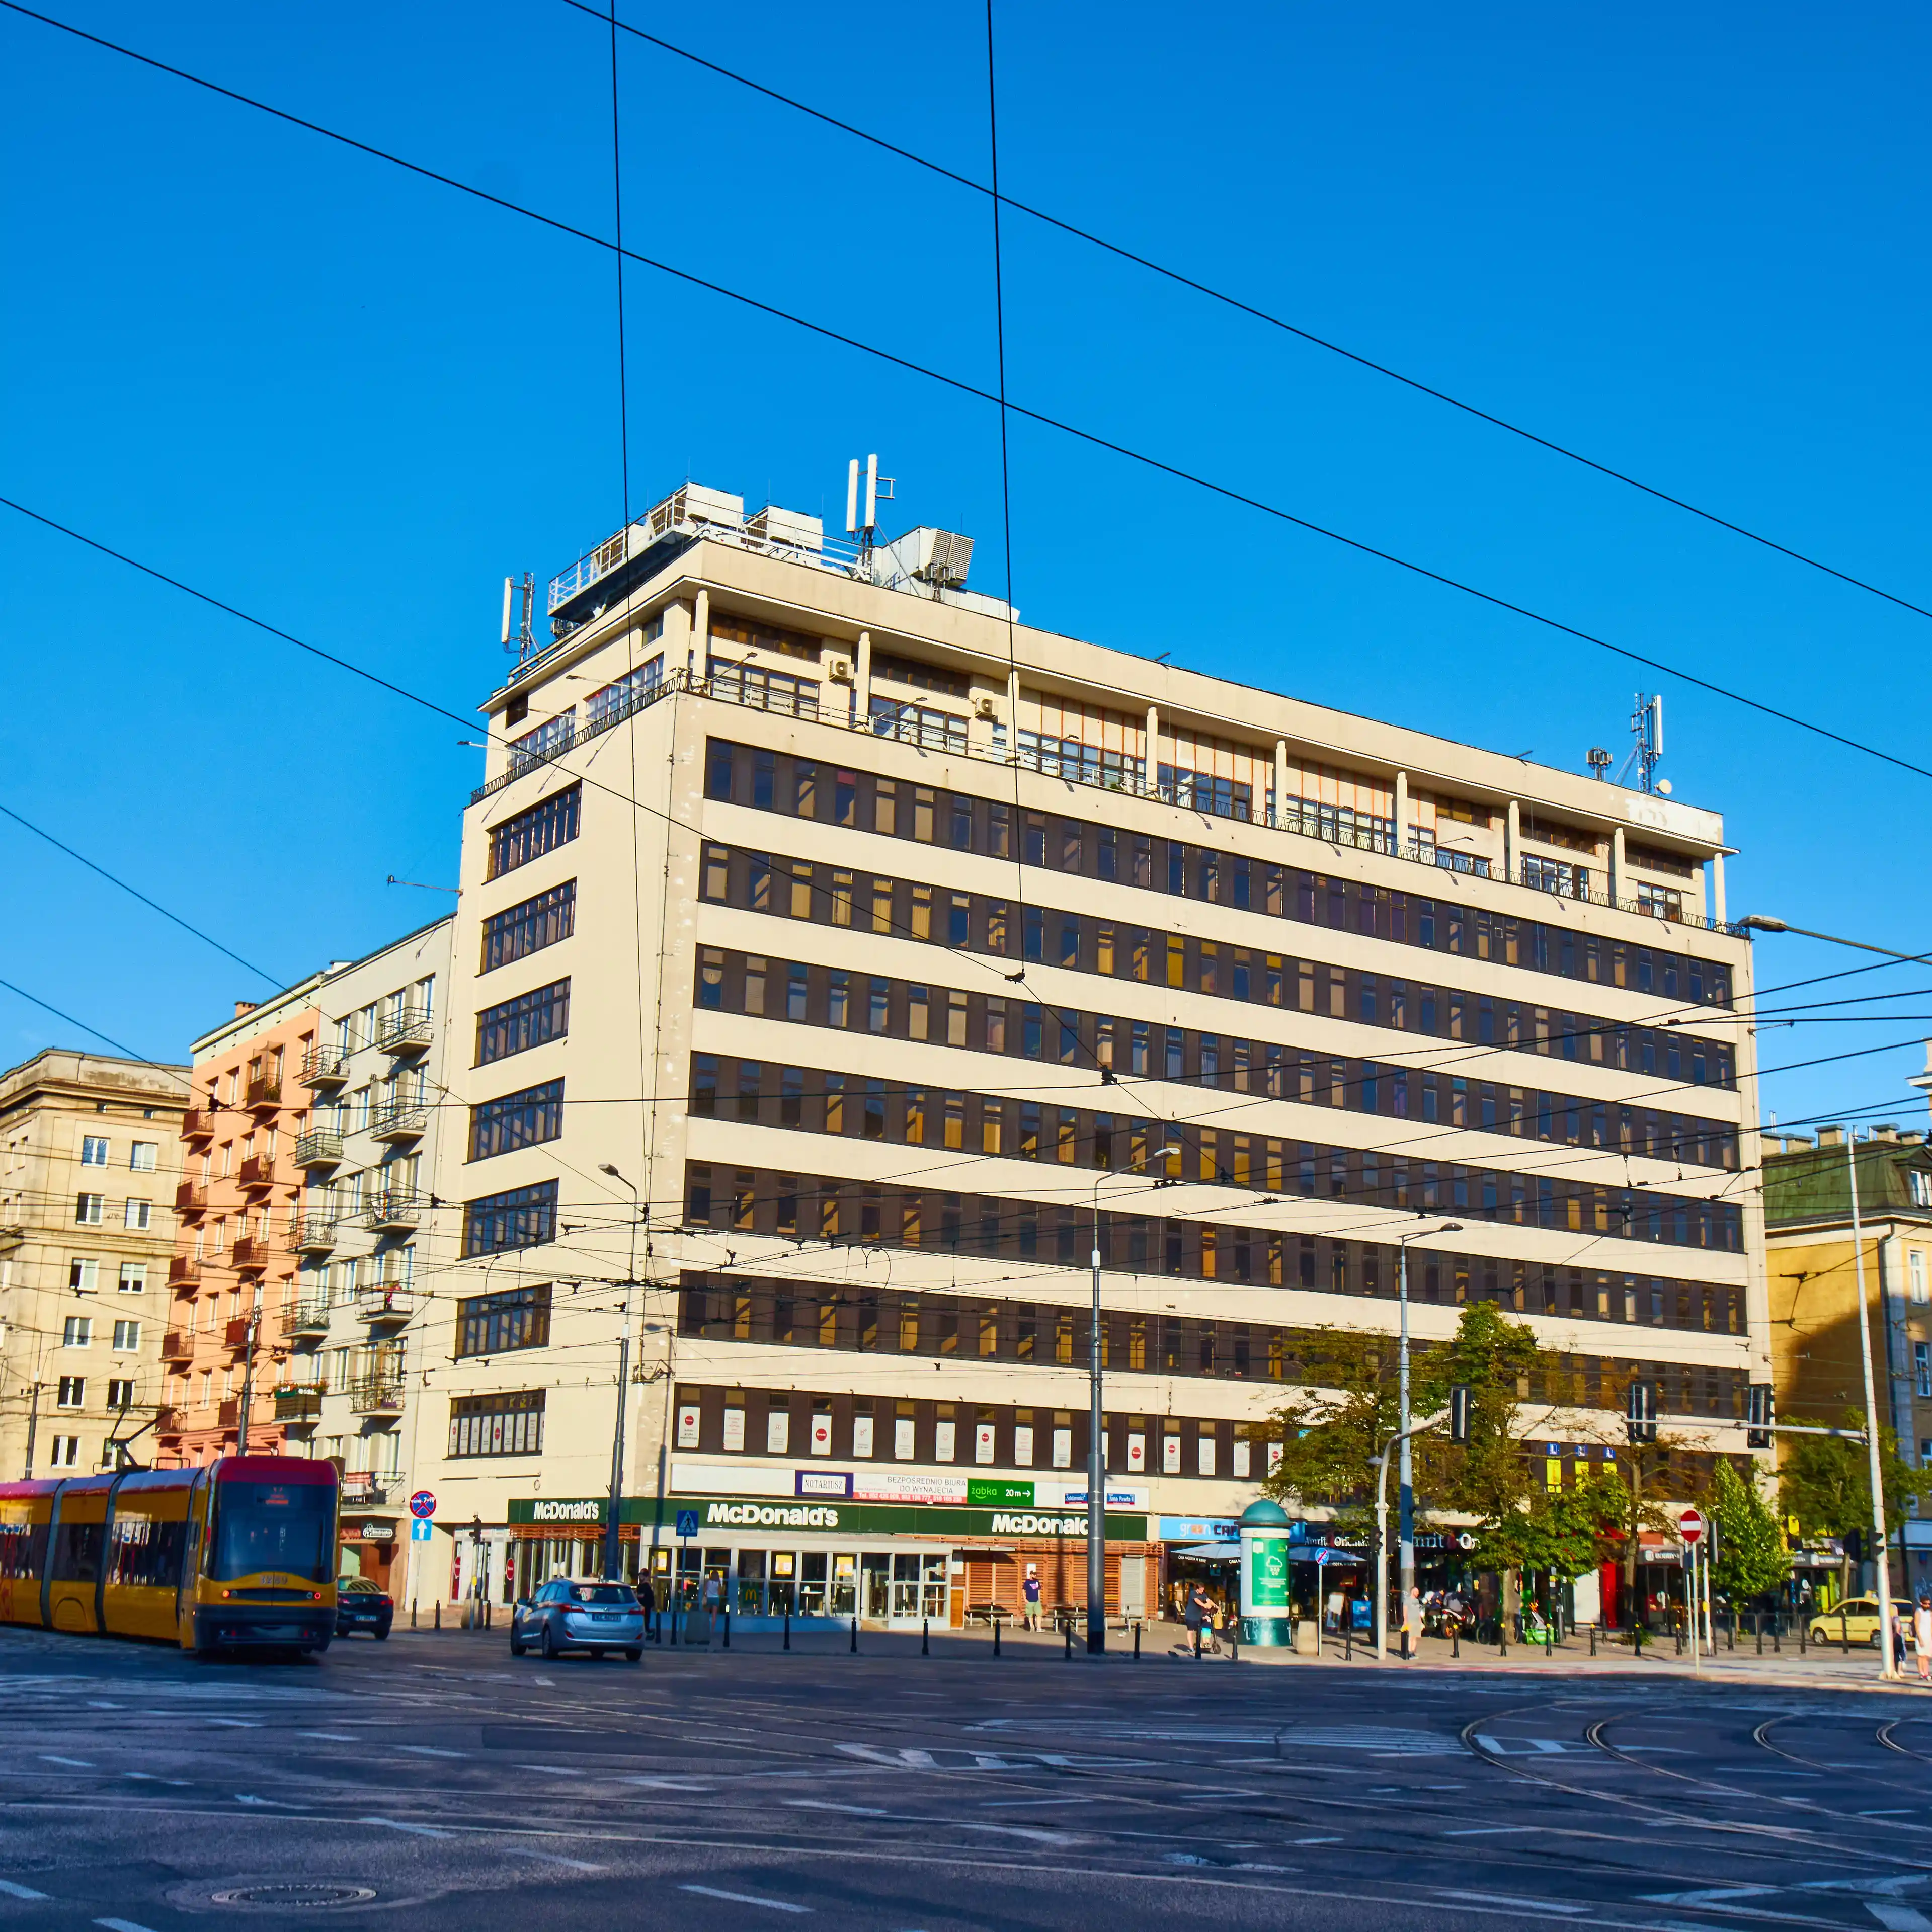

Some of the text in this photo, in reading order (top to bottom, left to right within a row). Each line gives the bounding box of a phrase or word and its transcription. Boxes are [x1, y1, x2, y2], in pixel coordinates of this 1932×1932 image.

[804, 1478, 843, 1490] NOTARIUSZ
[888, 1476, 966, 1487] BEZPOŚREDNIO BIURA
[912, 1485, 953, 1496] WYNAJĘCIA
[971, 1486, 997, 1495] żabka
[533, 1501, 599, 1520] McDonald's
[707, 1503, 839, 1527] McDonald's
[992, 1514, 1089, 1535] McDonald
[1413, 1533, 1445, 1548] mrit
